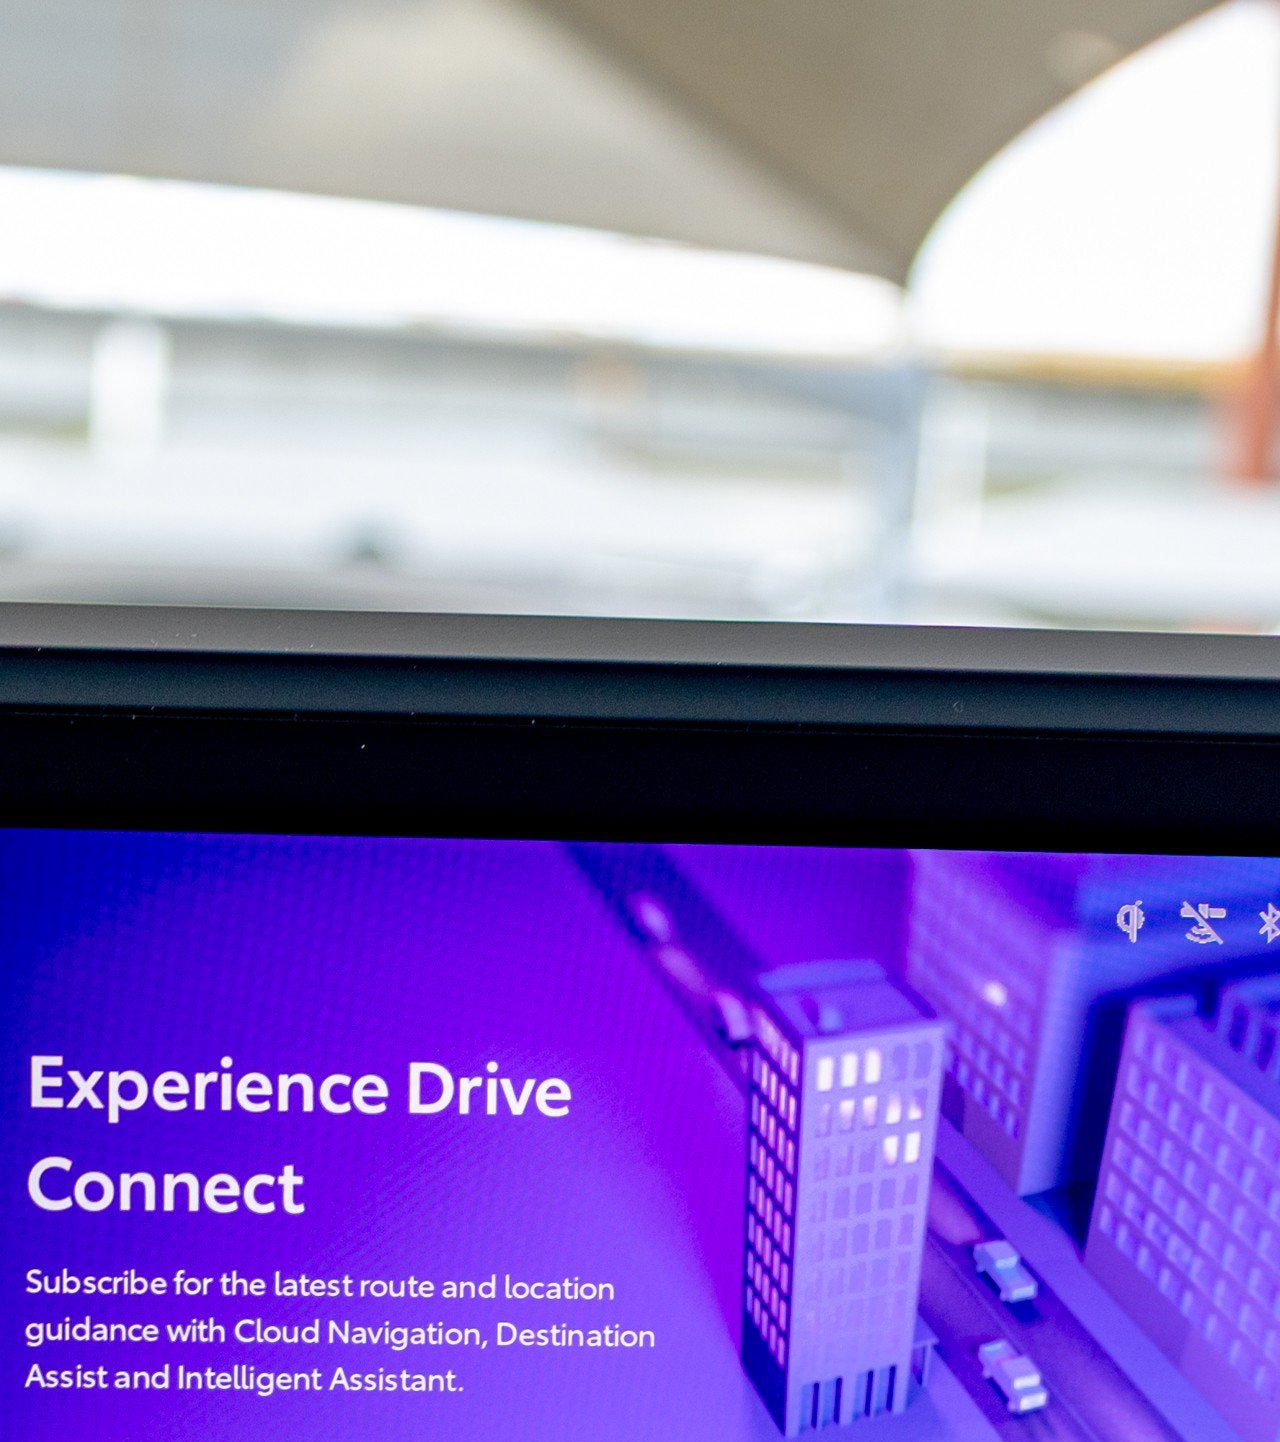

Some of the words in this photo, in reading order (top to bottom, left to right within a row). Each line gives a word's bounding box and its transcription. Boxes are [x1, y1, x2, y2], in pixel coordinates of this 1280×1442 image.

[29, 1054, 389, 1124] Experience
[408, 1060, 573, 1118] Drive
[26, 1155, 306, 1216] Connect
[25, 1268, 168, 1296] Subscribe
[173, 1269, 213, 1296] for
[219, 1270, 267, 1297] the
[273, 1271, 353, 1298] latest
[360, 1274, 435, 1299] route
[441, 1273, 496, 1300] and
[504, 1274, 615, 1302] location
[25, 1316, 160, 1348] guidance
[166, 1317, 226, 1344] with
[234, 1318, 320, 1346] Cloud
[328, 1320, 489, 1351] Navigation,
[496, 1321, 655, 1350] Destination
[24, 1363, 109, 1390] Assist
[114, 1363, 170, 1391] and
[178, 1364, 322, 1397] Intelligent
[328, 1366, 465, 1394] Assistant.
